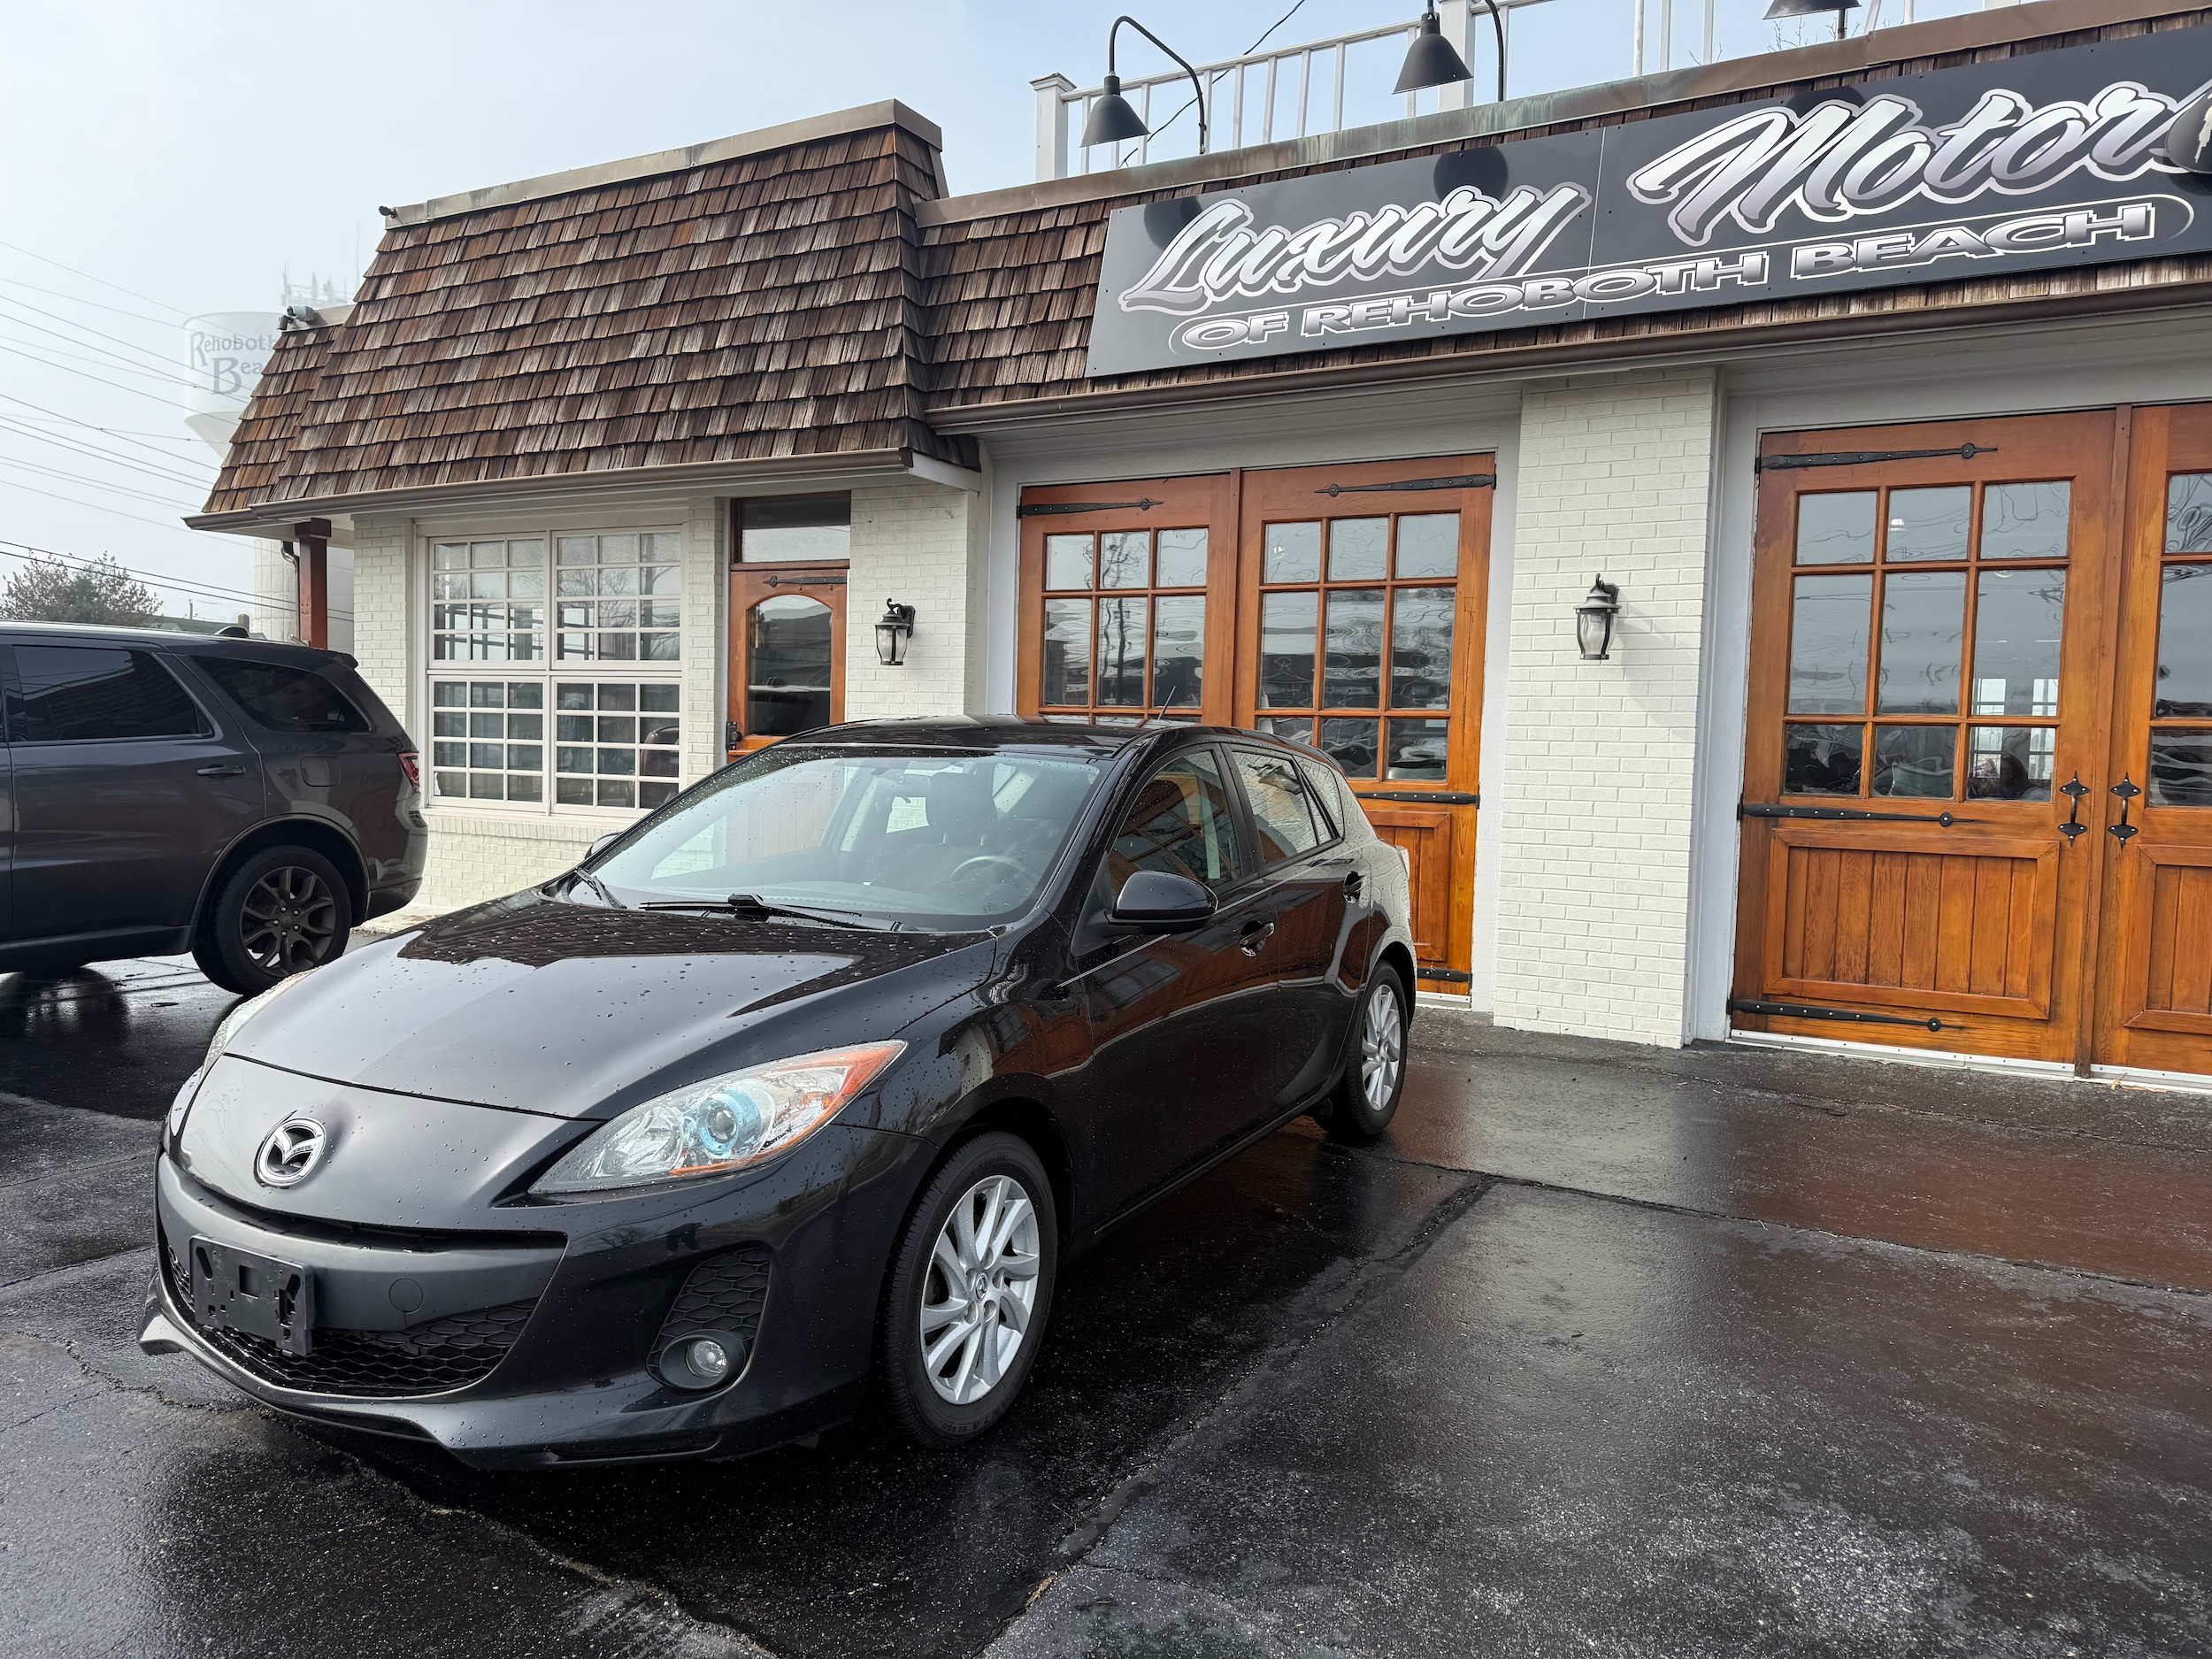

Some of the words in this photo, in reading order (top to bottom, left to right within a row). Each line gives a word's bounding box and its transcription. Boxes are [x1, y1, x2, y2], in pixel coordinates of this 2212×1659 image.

[1118, 180, 1593, 316] Luxury
[1625, 80, 2212, 247] Motor
[1182, 311, 1288, 350] OF
[1300, 249, 1770, 338] REHOBOTH
[1789, 201, 2156, 280] BEACH
